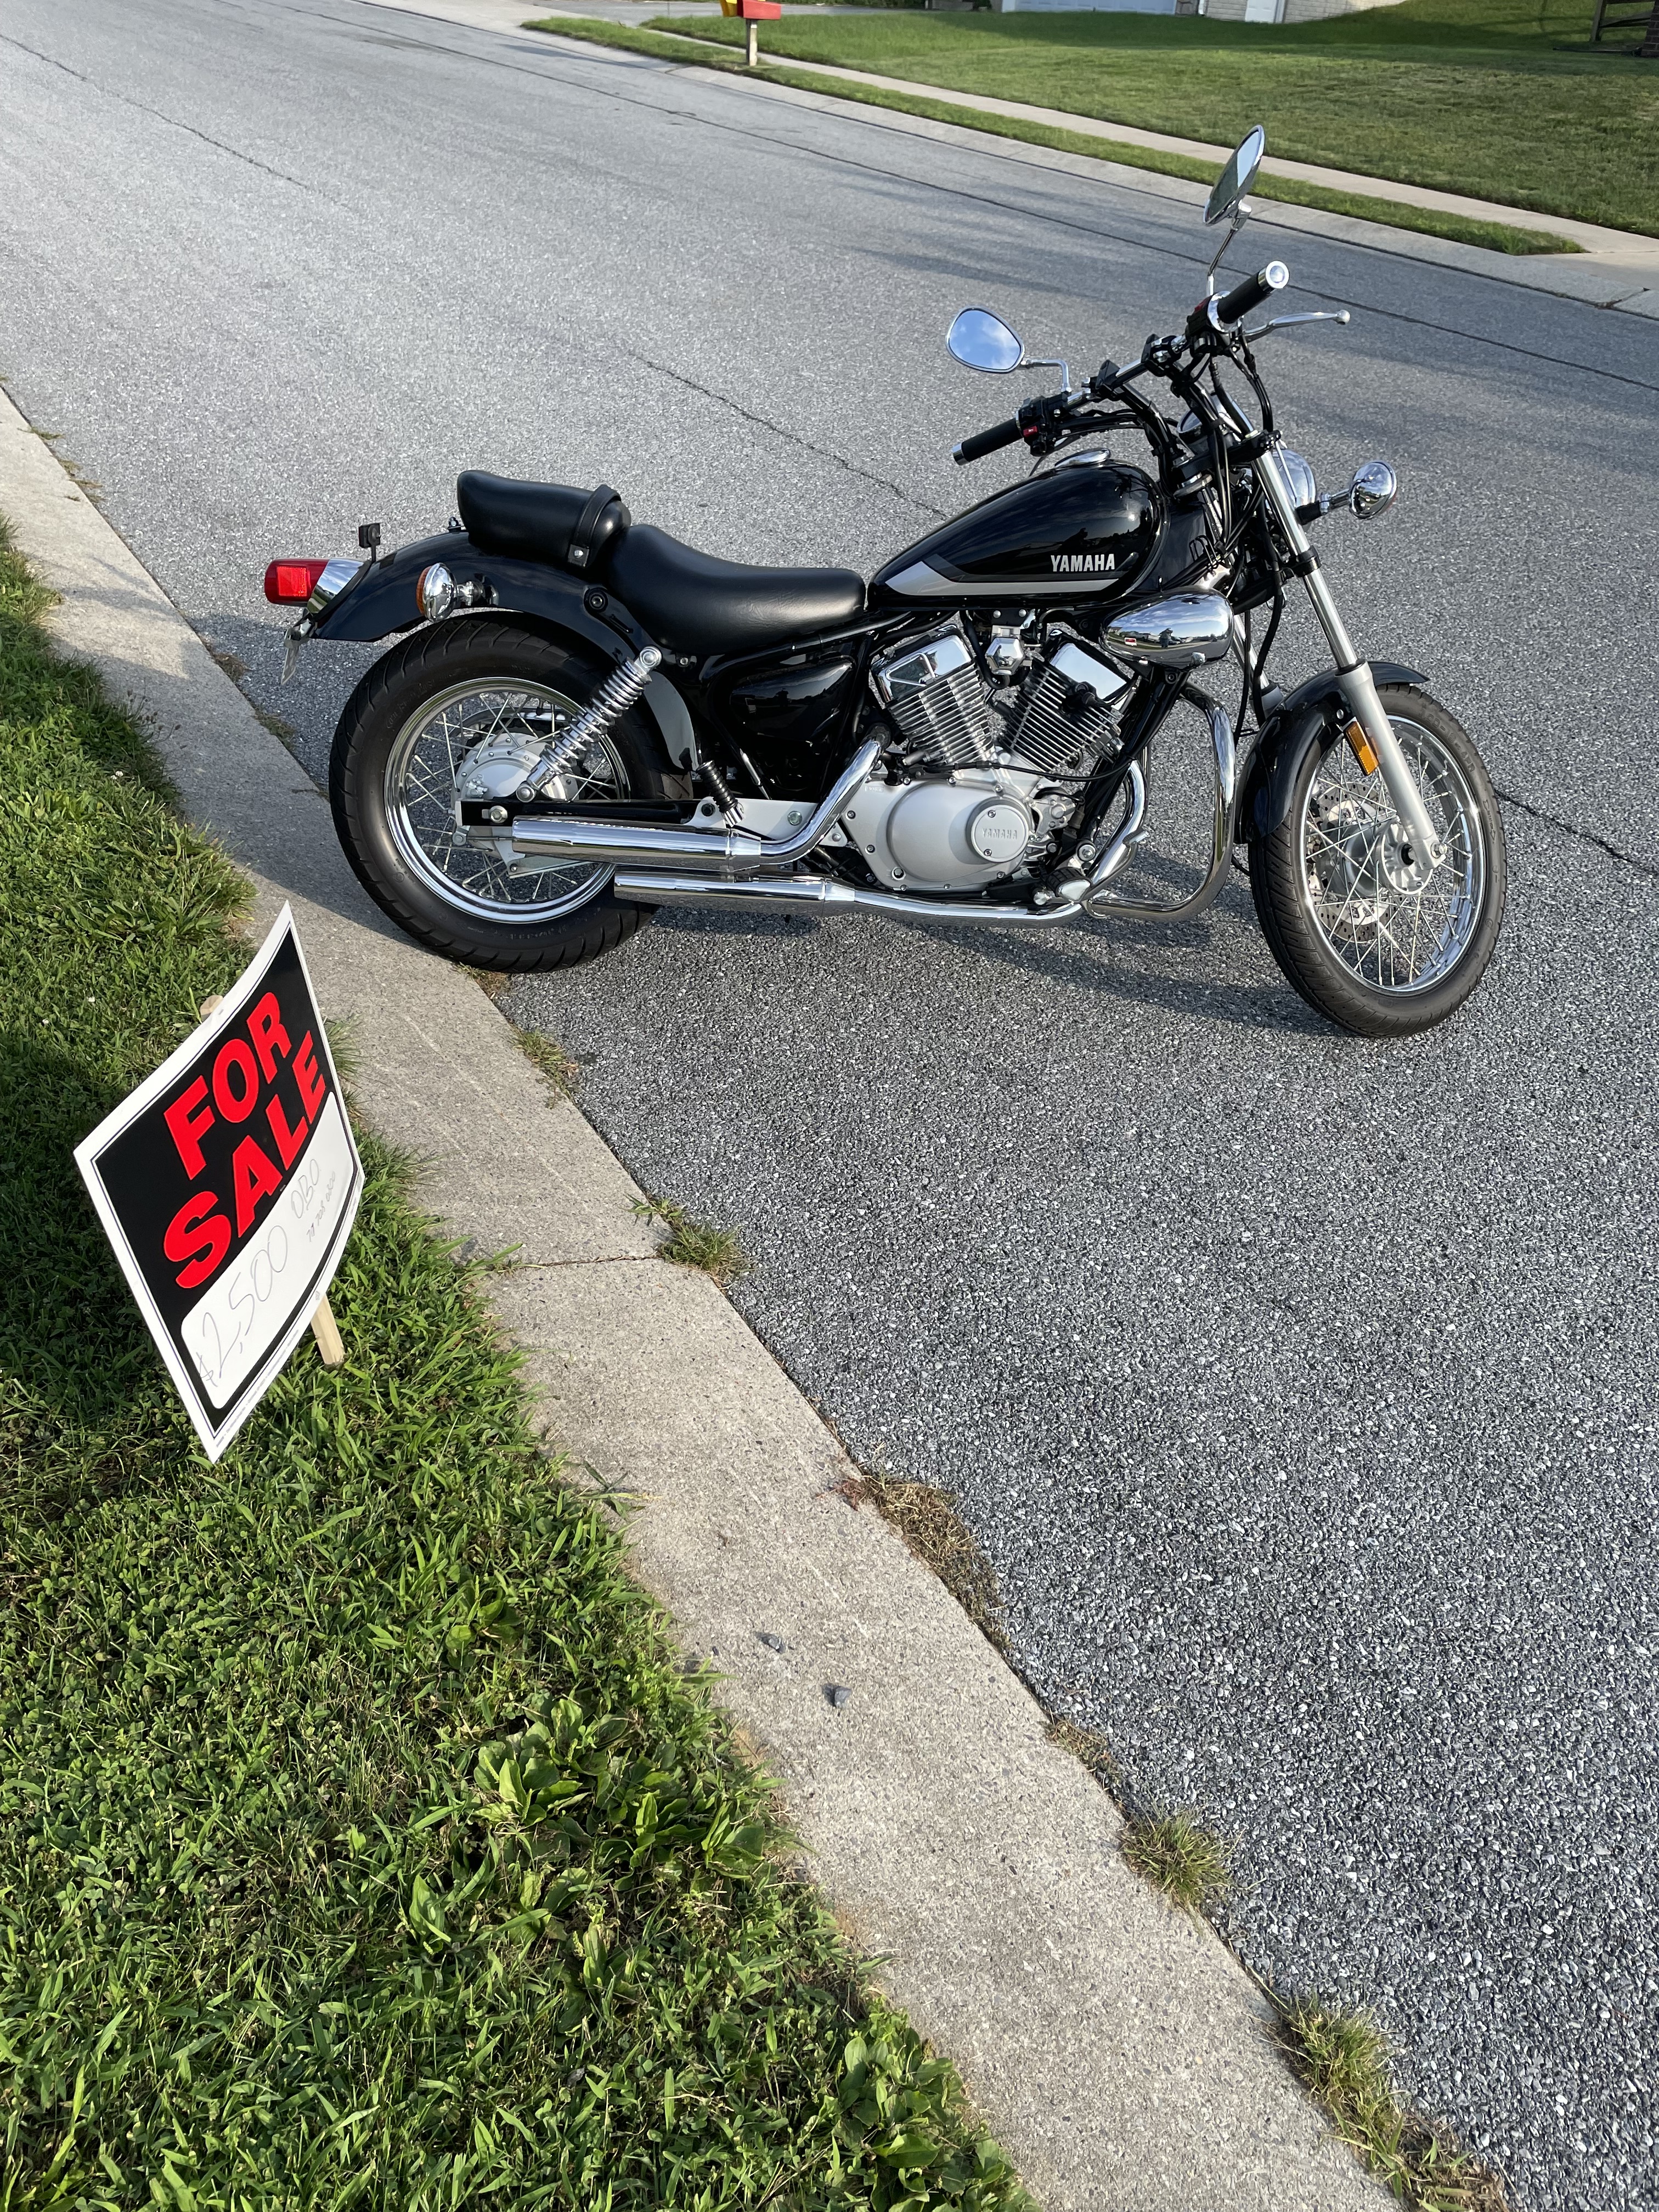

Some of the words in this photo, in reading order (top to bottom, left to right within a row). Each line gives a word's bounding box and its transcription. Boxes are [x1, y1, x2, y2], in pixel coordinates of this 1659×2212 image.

[1051, 554, 1115, 572] YAMAHA
[983, 828, 1017, 840] YAMAHA
[163, 991, 292, 1181] FOR
[163, 1030, 326, 1289] SALE
[196, 1225, 288, 1387] $2,500
[291, 1159, 319, 1219] OBO
